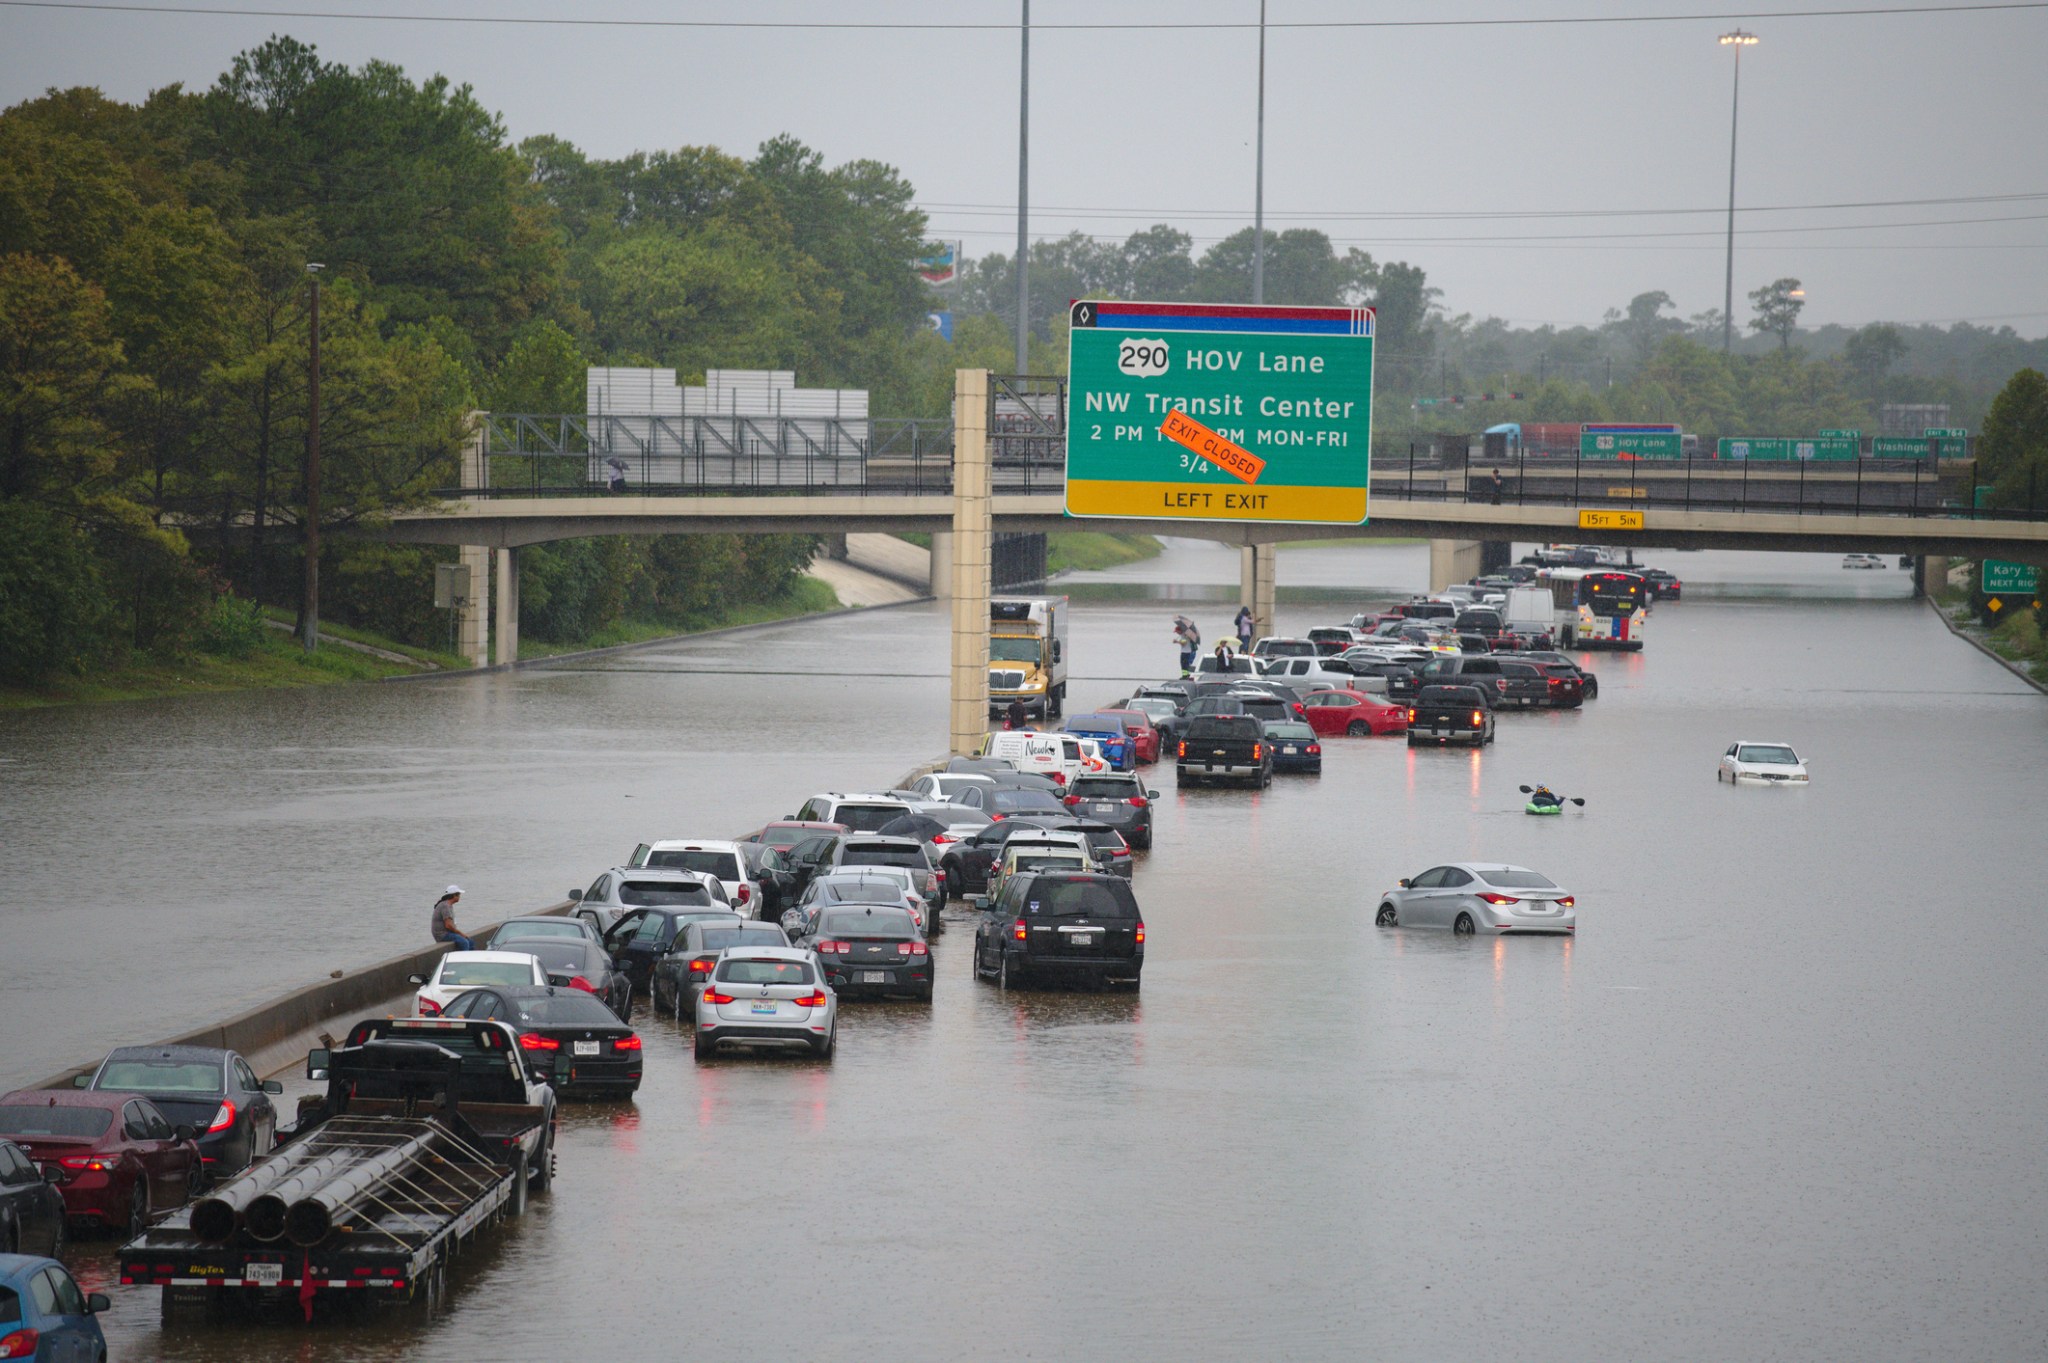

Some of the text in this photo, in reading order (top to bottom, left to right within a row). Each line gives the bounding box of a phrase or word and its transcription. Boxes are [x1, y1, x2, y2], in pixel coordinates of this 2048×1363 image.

[1121, 346, 1325, 373] 290 HOV Lane
[1086, 392, 1354, 418] NW Transit Center
[1091, 425, 1102, 440] 2
[1115, 426, 1143, 441] PM
[1155, 427, 1176, 442] T
[1257, 429, 1348, 447] MON-FRI
[1643, 439, 1666, 447] Lane
[1168, 417, 1256, 475] EXIT CLOSED
[1877, 443, 1961, 454] Washingto Ave
[1179, 454, 1209, 474] 3/4
[1164, 492, 1269, 509] LEFT EXIT
[1990, 580, 2014, 588] NEXT
[189, 1265, 225, 1275] BigTex
